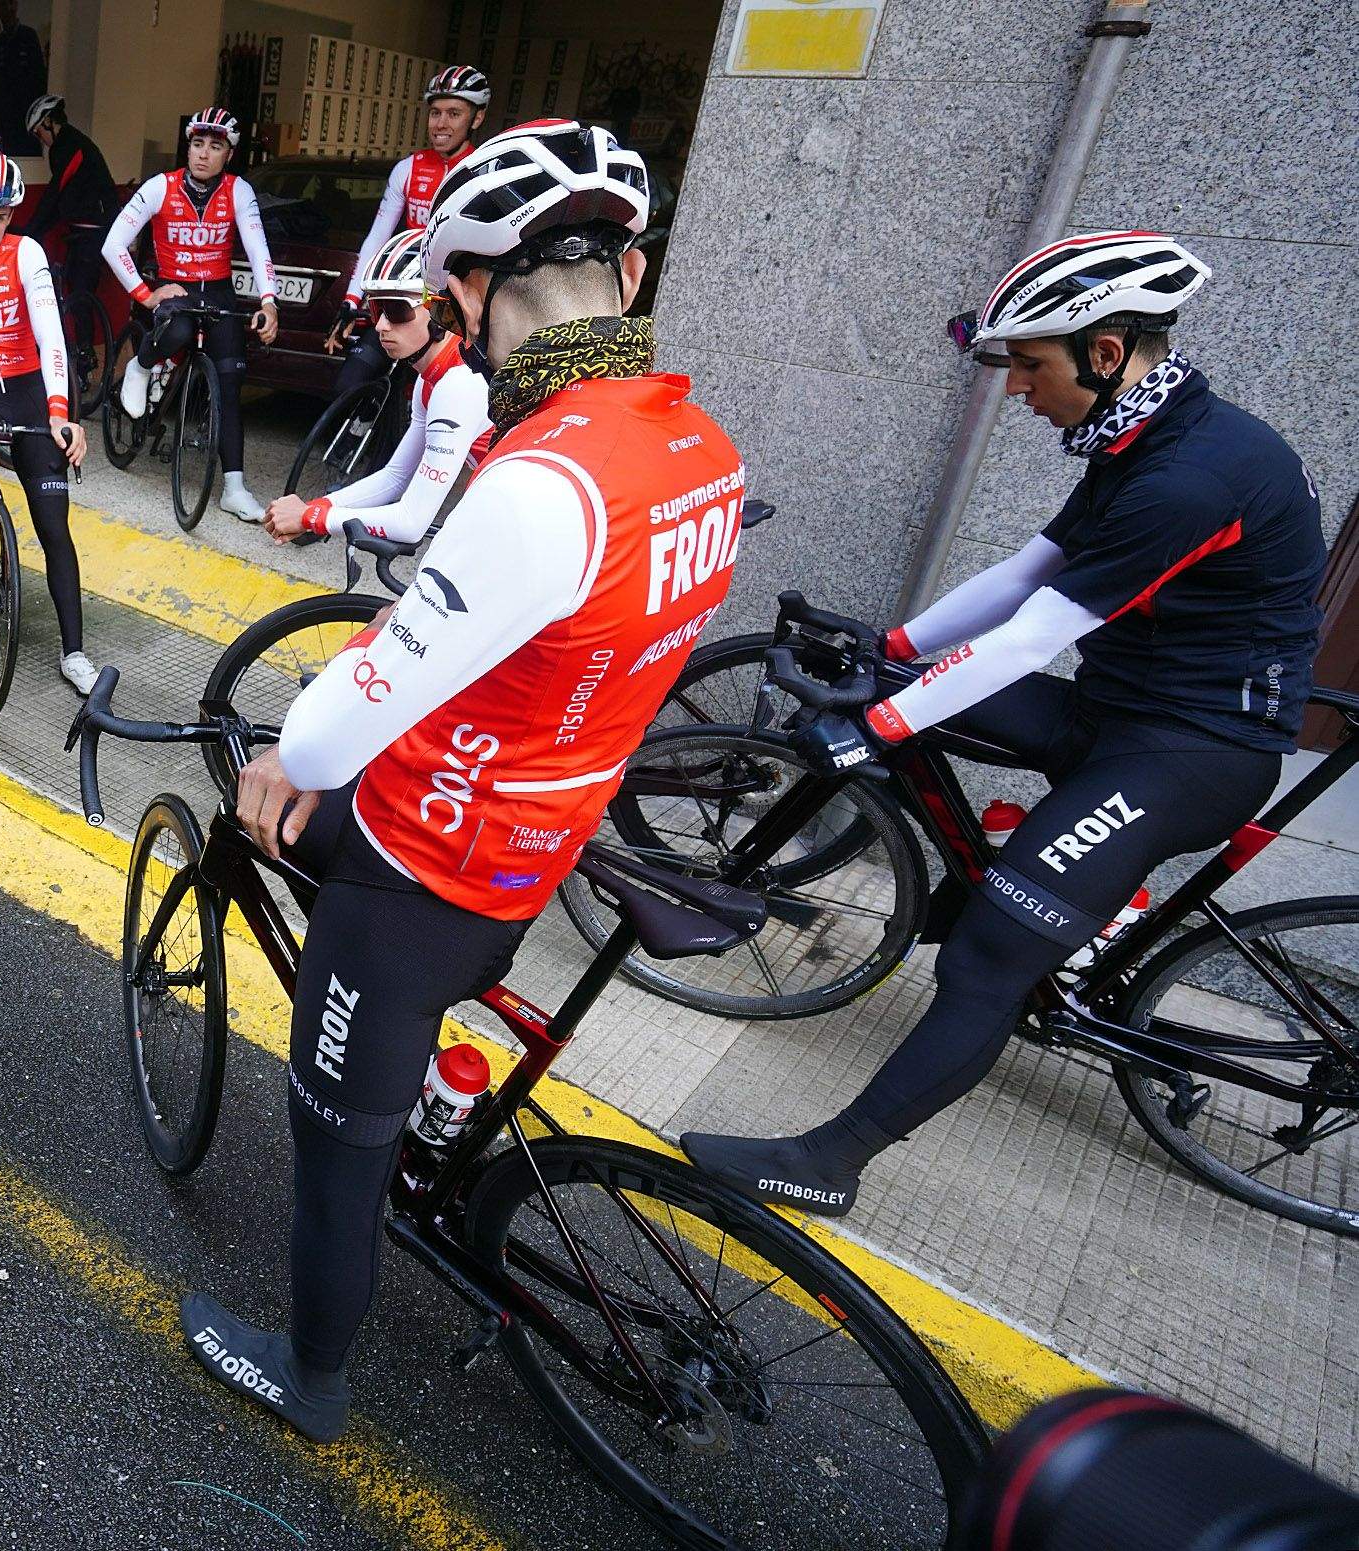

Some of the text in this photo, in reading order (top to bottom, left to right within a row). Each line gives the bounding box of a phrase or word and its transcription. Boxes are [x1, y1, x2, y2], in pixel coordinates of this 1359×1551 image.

[510, 205, 536, 228] DOMO
[167, 227, 229, 246] FROIZ
[119, 252, 135, 275] FROIZ
[1012, 280, 1043, 306] FROIZ
[1066, 283, 1134, 321] Spiuk
[53, 349, 64, 378] FROIZ
[649, 462, 745, 525] supermercad
[921, 642, 974, 687] FROIZ
[555, 649, 613, 746] OTTOBOSLE
[832, 746, 870, 769] FROIZ
[508, 836, 547, 850] LIBRE
[1038, 792, 1145, 874] FROIZ
[315, 972, 361, 1082] FROIZ
[758, 1179, 846, 1205] OTTOBOSLEY
